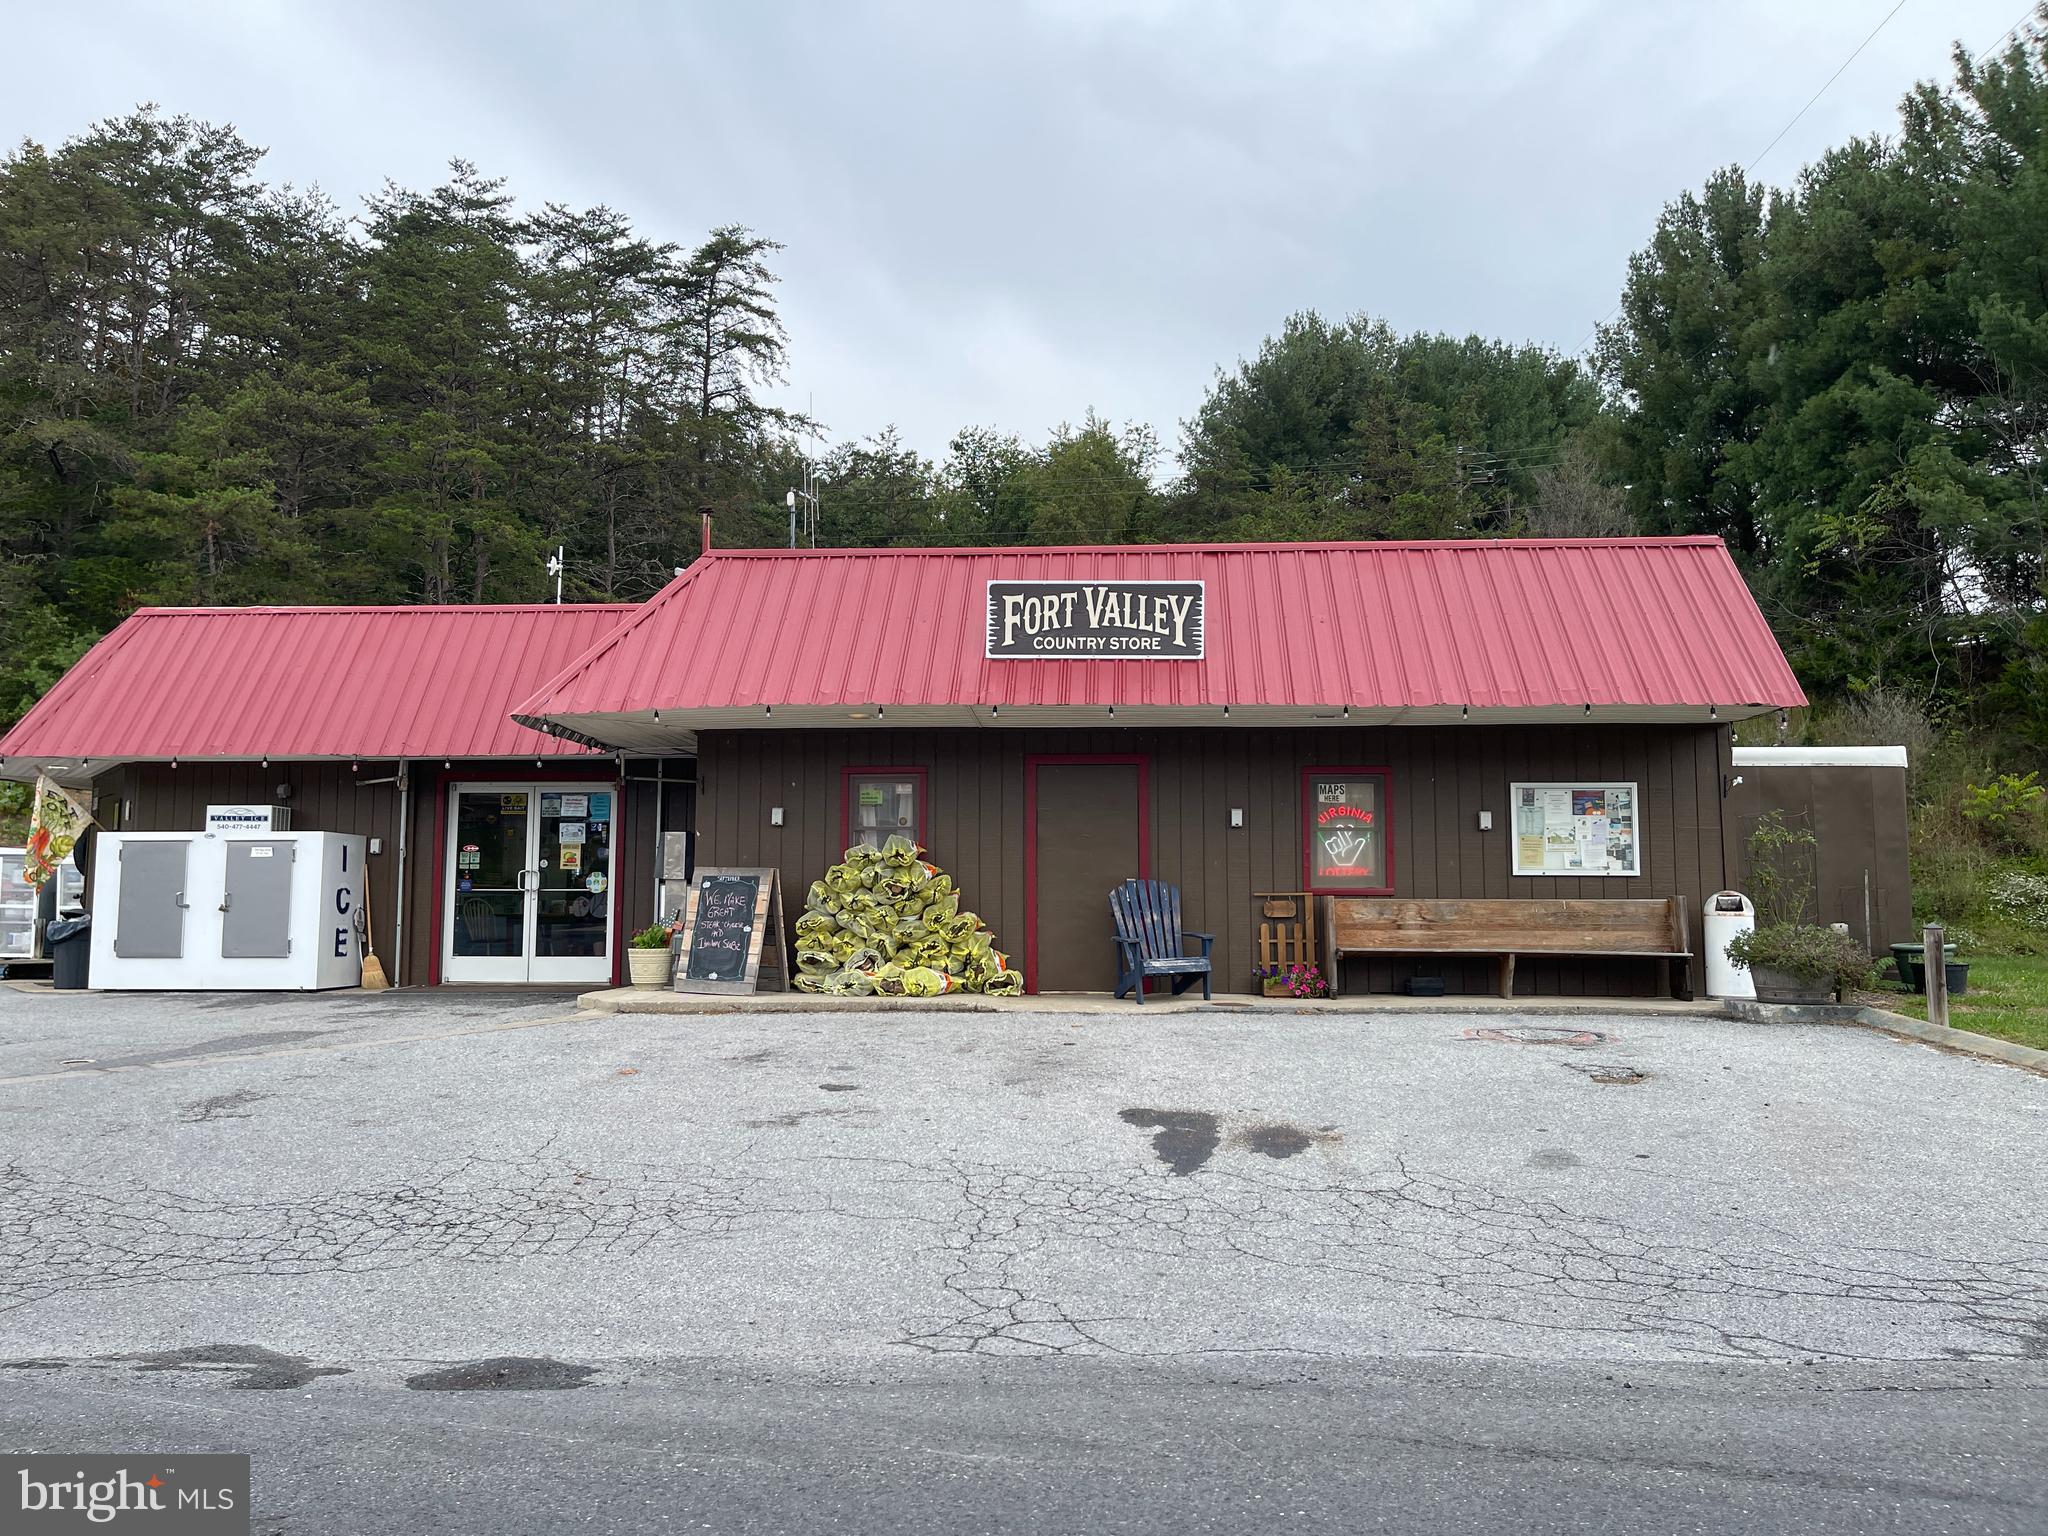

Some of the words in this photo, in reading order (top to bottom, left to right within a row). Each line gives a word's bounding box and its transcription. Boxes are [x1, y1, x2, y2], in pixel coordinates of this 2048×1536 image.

[1001, 591, 1078, 647] FORT
[1082, 586, 1194, 648] VALLEY
[1033, 636, 1106, 650] COUNTRY
[1109, 636, 1162, 650] STORE
[1319, 784, 1345, 795] MAPS
[1318, 805, 1373, 824] VIRGINIA
[705, 889, 720, 906] WE
[724, 892, 746, 907] MAKE
[707, 906, 735, 918] GREAT
